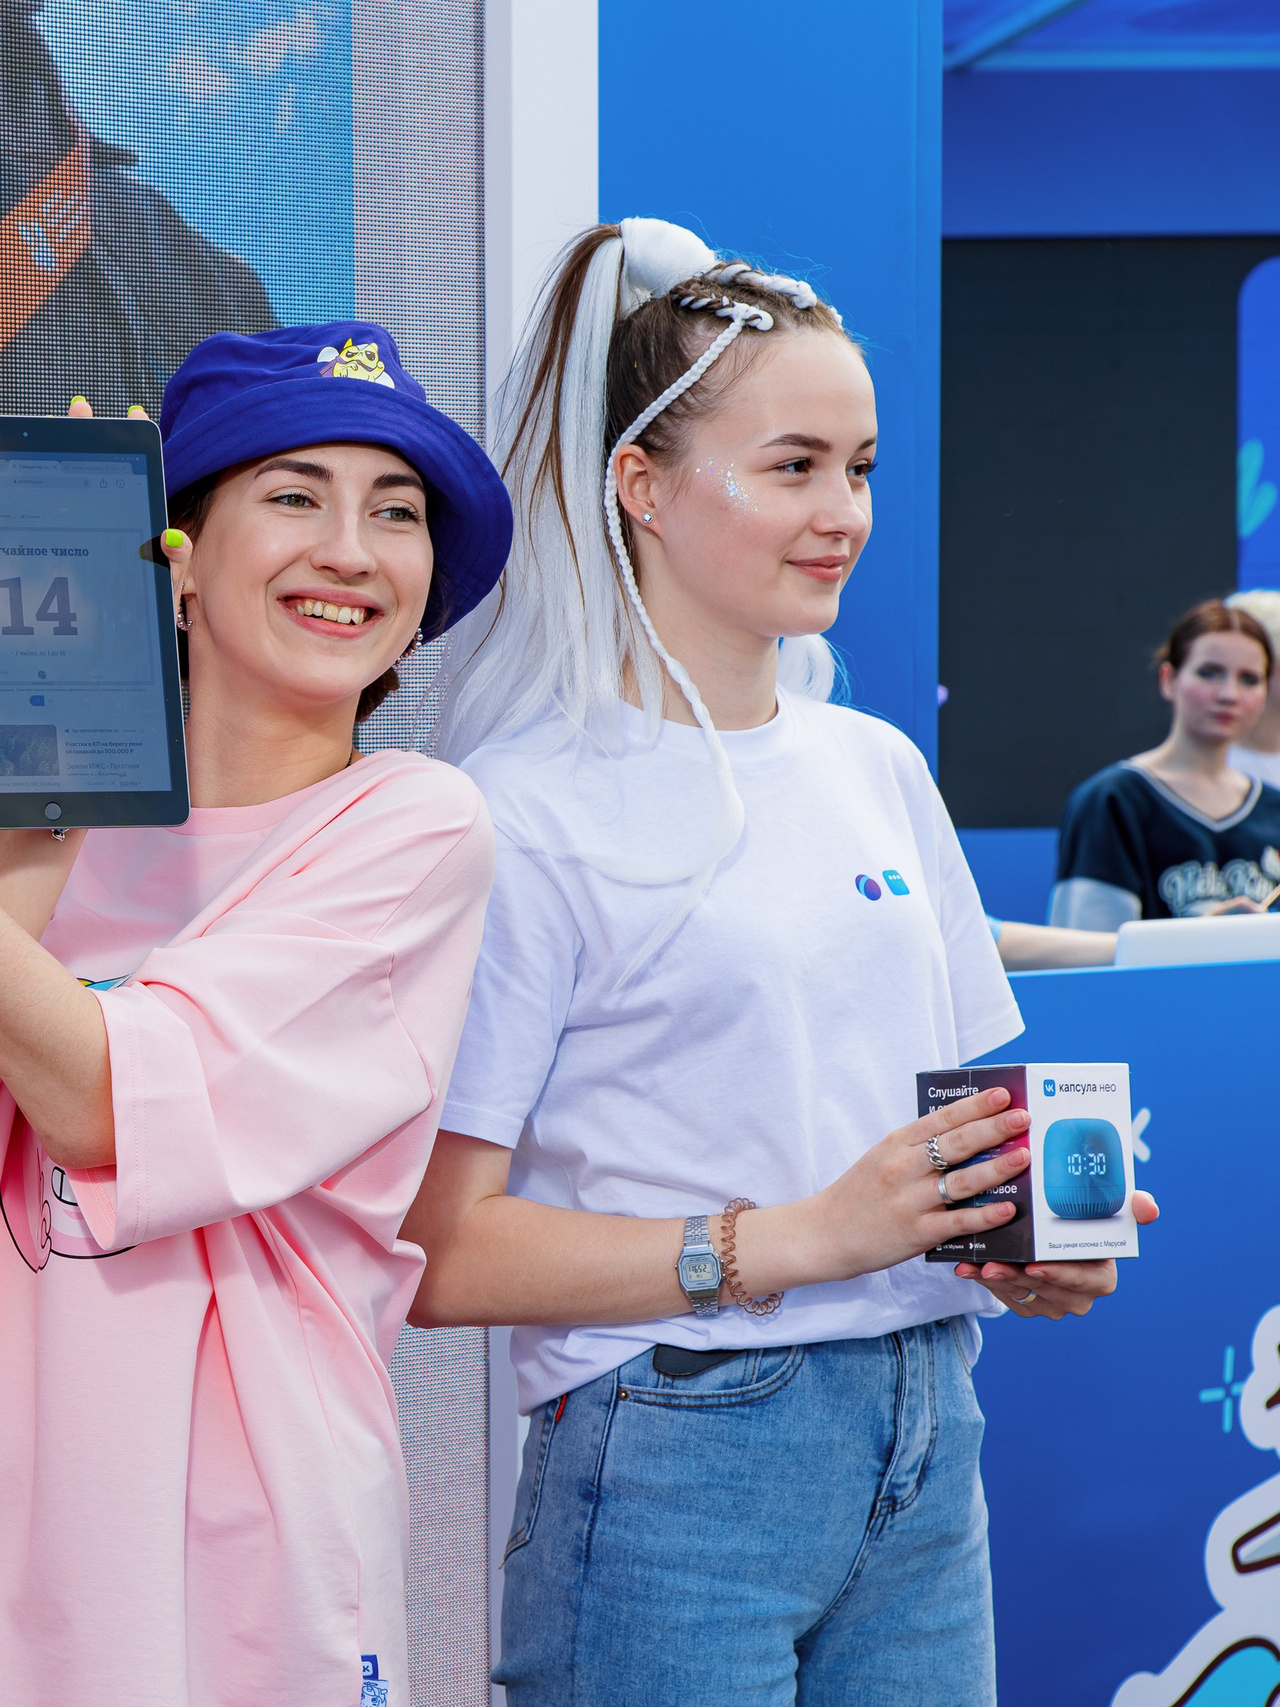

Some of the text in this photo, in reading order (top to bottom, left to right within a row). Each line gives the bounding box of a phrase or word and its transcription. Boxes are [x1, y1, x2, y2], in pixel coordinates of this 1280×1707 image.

[50, 547, 90, 557] число
[928, 1084, 979, 1100] Слушайте
[1059, 1083, 1097, 1095] капсула
[1099, 1083, 1117, 1092] нео
[1067, 1153, 1106, 1175] 10:30
[1063, 1242, 1078, 1250] умная
[1103, 1240, 1127, 1249] Марусей
